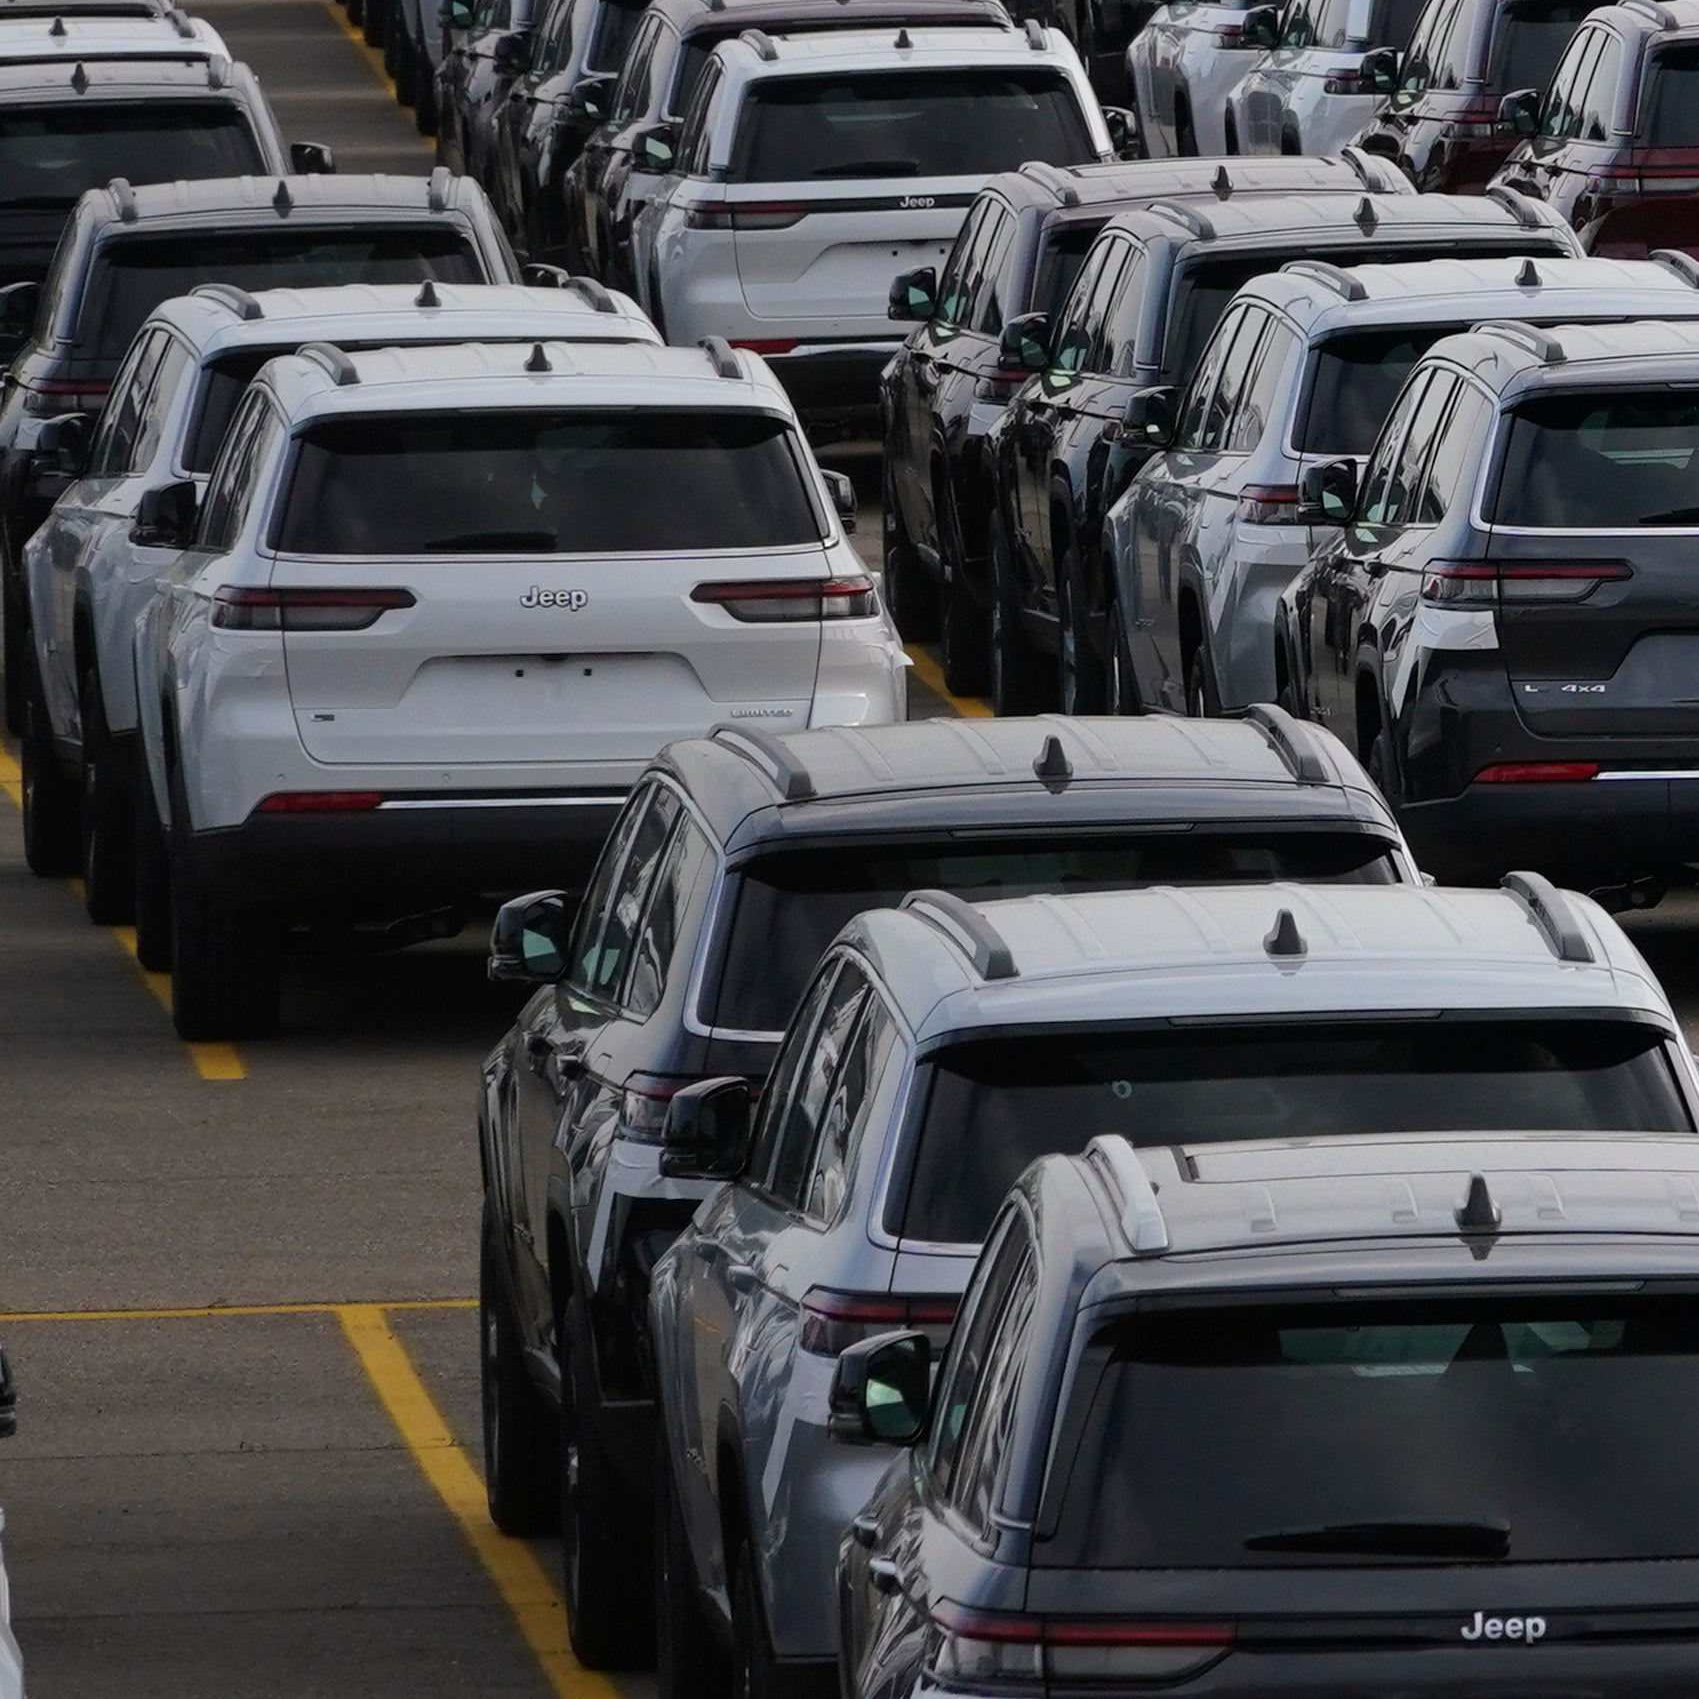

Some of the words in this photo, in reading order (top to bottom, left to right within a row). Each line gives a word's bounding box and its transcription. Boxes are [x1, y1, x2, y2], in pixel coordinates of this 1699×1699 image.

[900, 196, 934, 208] Jeep
[520, 585, 588, 611] Jeep
[1562, 685, 1605, 693] 4x4
[1461, 1612, 1546, 1644] Jeep
